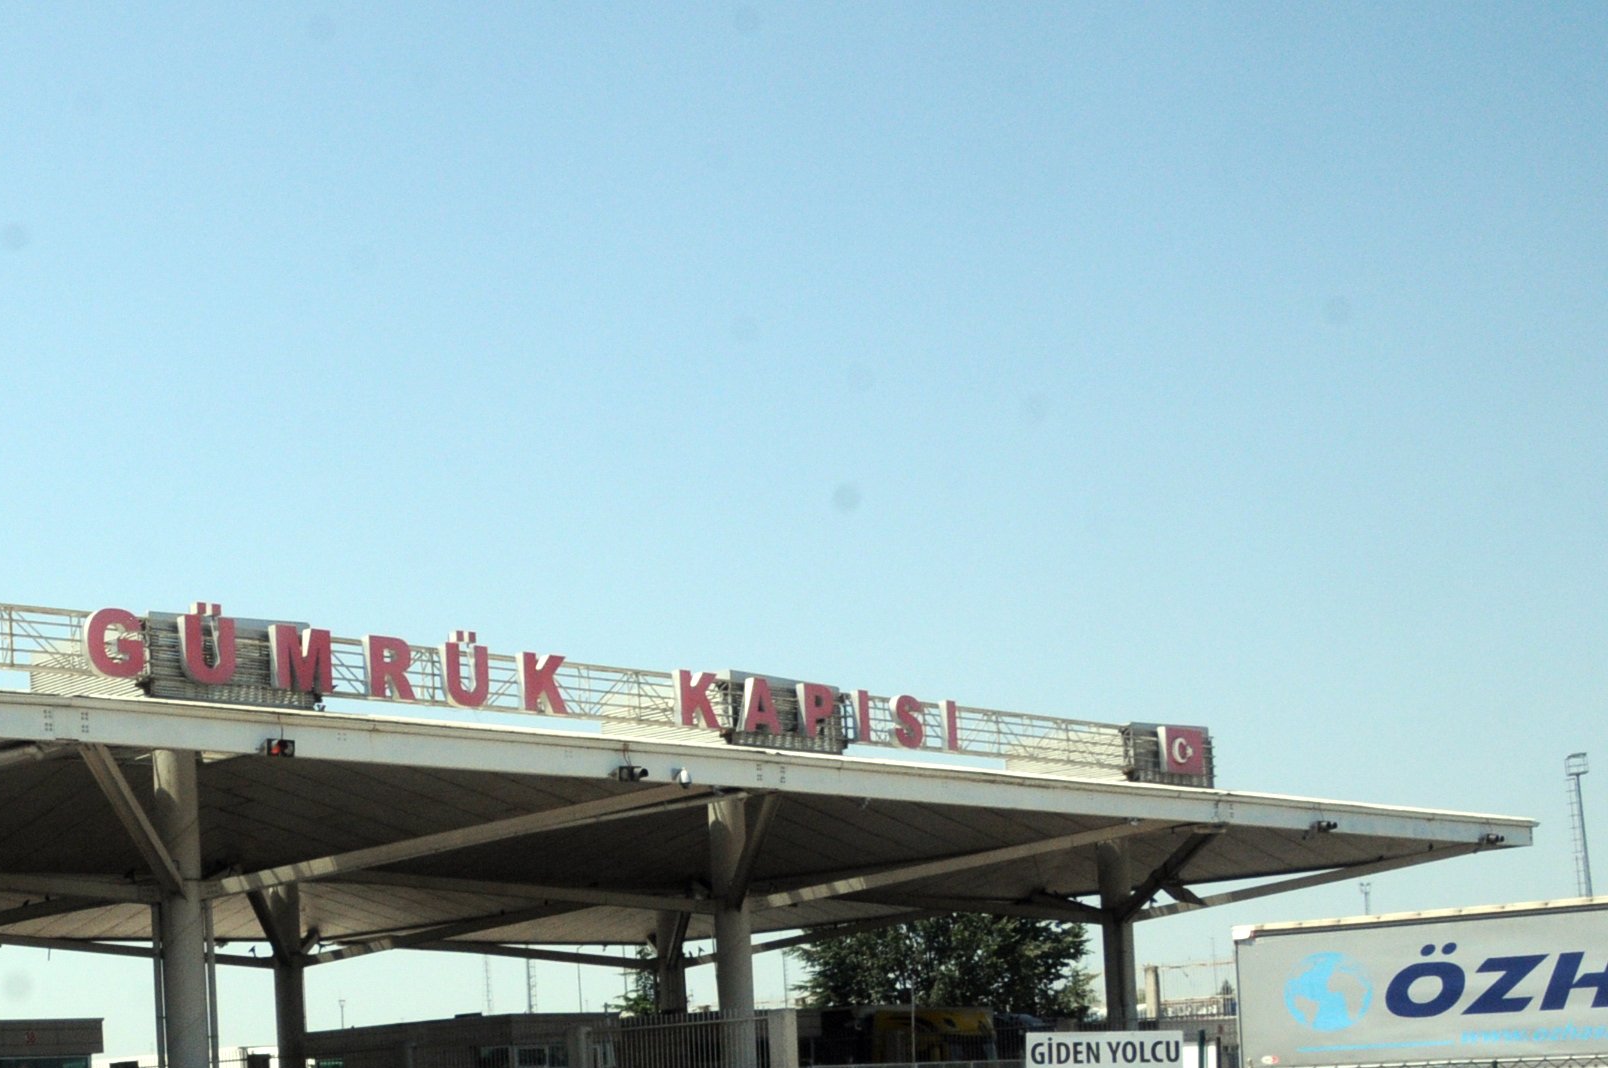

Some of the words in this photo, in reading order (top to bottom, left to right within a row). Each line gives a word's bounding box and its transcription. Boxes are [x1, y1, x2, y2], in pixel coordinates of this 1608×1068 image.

[81, 602, 570, 716] GÜMRÜK
[672, 669, 960, 752] KAPISI
[1031, 1037, 1101, 1064] GİDEN
[1107, 1041, 1180, 1063] YOLCU
